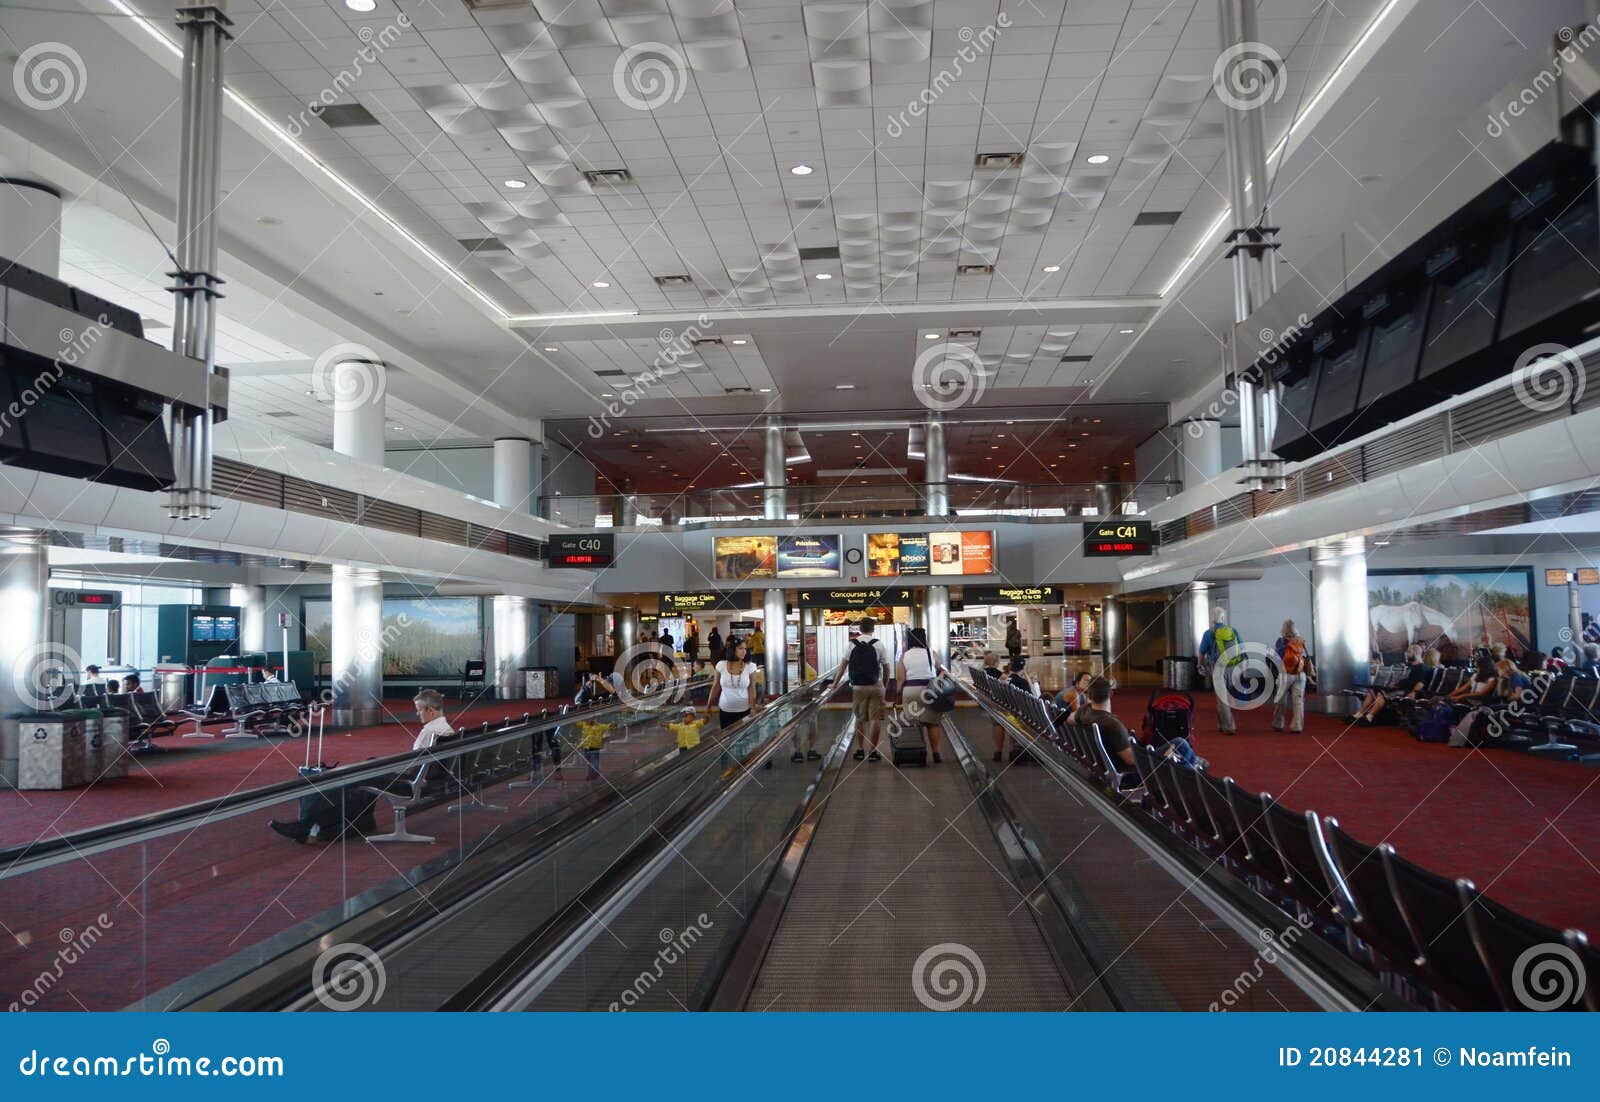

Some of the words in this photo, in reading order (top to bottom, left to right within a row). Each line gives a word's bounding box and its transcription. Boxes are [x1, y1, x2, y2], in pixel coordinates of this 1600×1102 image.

[1117, 526, 1136, 538] C41
[579, 539, 600, 550] C40
[56, 591, 75, 605] C40
